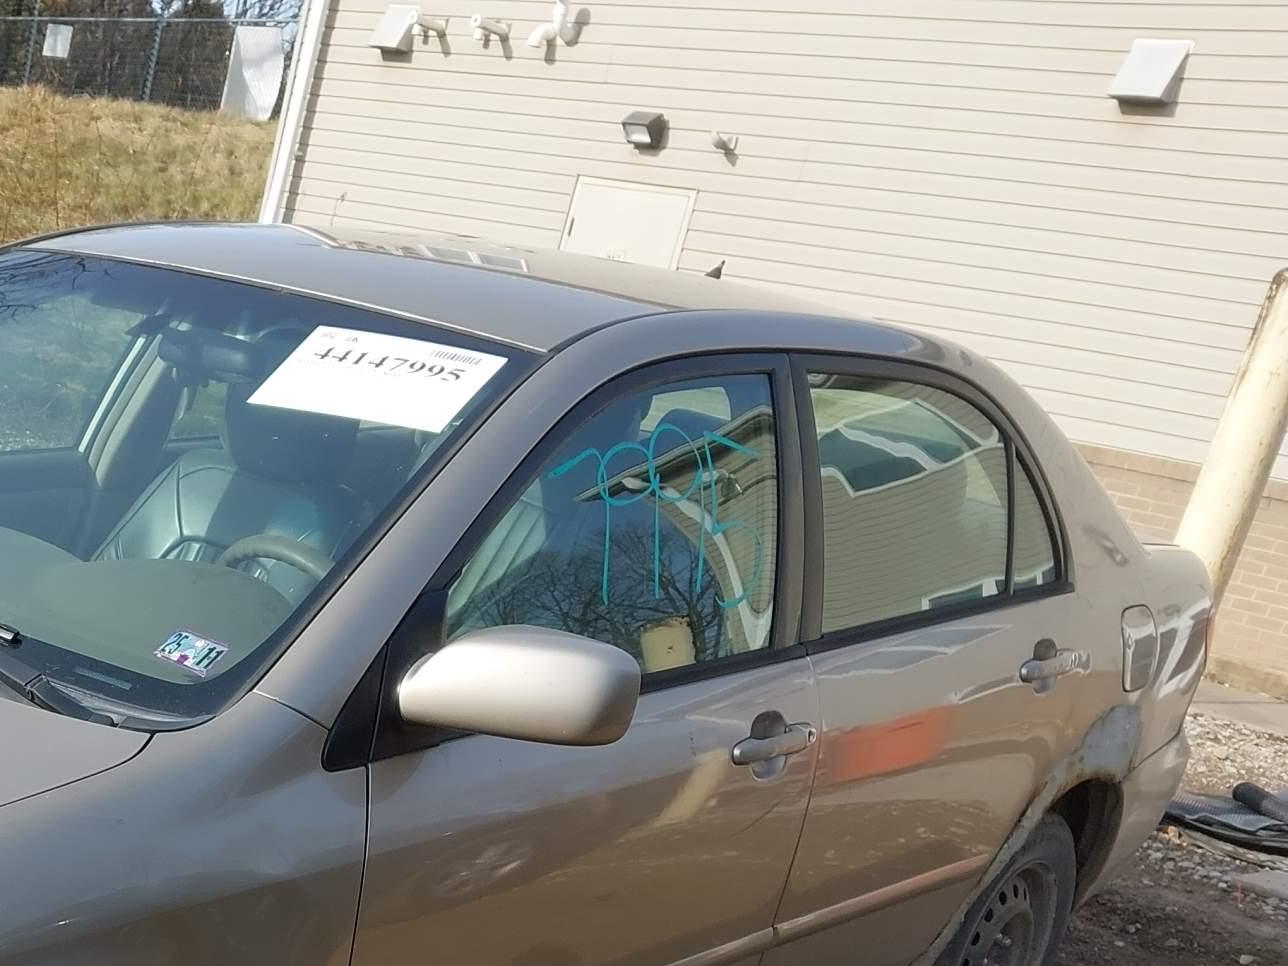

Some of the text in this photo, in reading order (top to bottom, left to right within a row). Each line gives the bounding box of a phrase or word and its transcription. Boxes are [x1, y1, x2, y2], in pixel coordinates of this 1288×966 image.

[313, 346, 468, 382] 44147995
[159, 632, 225, 670] 25 11
